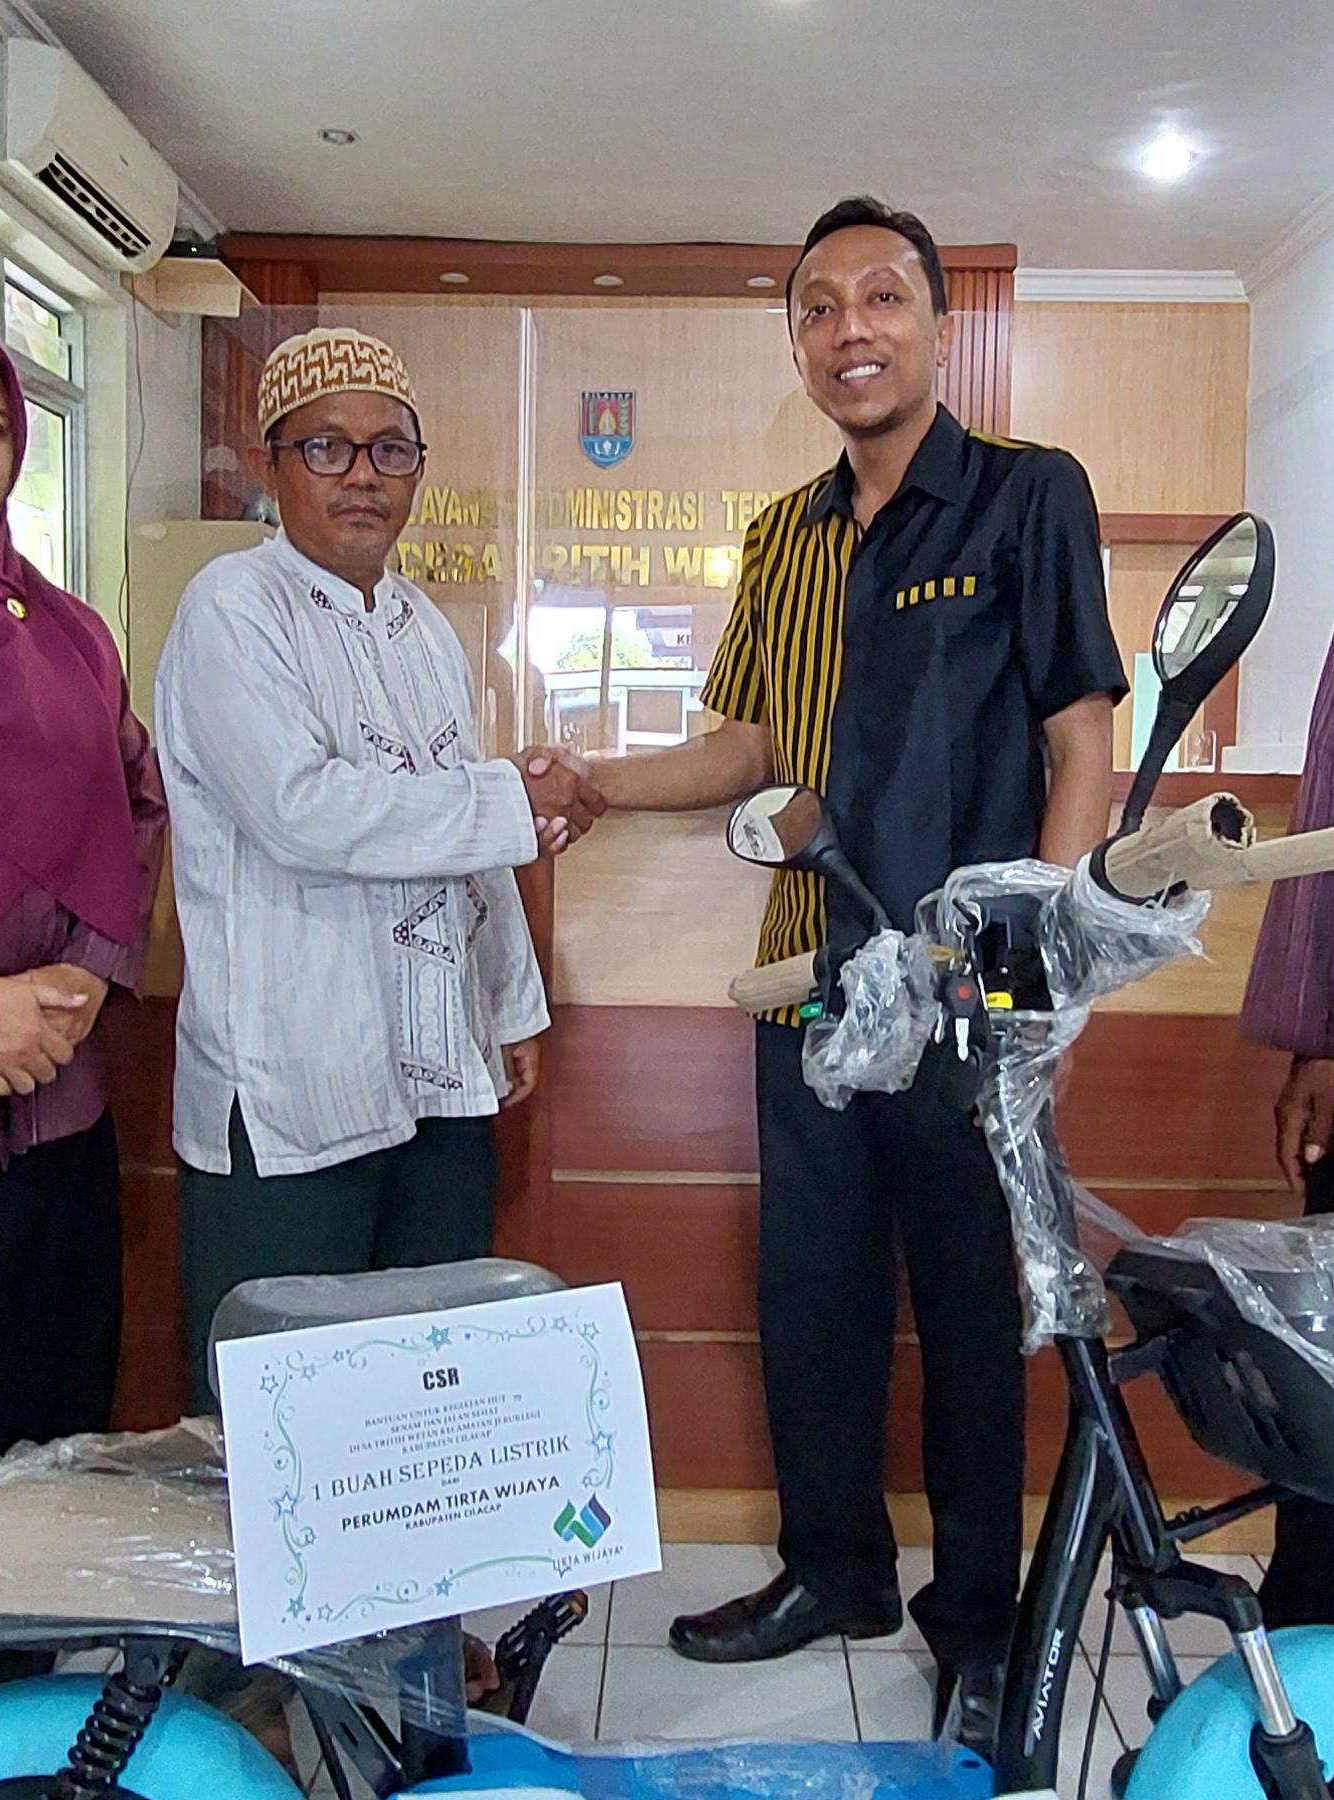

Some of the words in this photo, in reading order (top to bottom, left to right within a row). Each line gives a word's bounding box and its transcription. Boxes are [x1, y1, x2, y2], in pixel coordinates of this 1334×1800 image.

[722, 490, 786, 532] TER
[529, 543, 650, 588] RITIH
[422, 1367, 460, 1391] CSR
[311, 1482, 321, 1501] 1
[331, 1468, 393, 1499] BUAH
[399, 1451, 483, 1484] SEPEDA
[490, 1434, 571, 1466] LISTRIK
[341, 1498, 441, 1533] PERUMDAM
[445, 1489, 490, 1508] TIRTA
[494, 1475, 560, 1500] WIJAYA
[405, 1511, 461, 1531] KABUPATEN
[464, 1503, 503, 1518] CILACAP
[1031, 1627, 1065, 1741] AVIATOR
